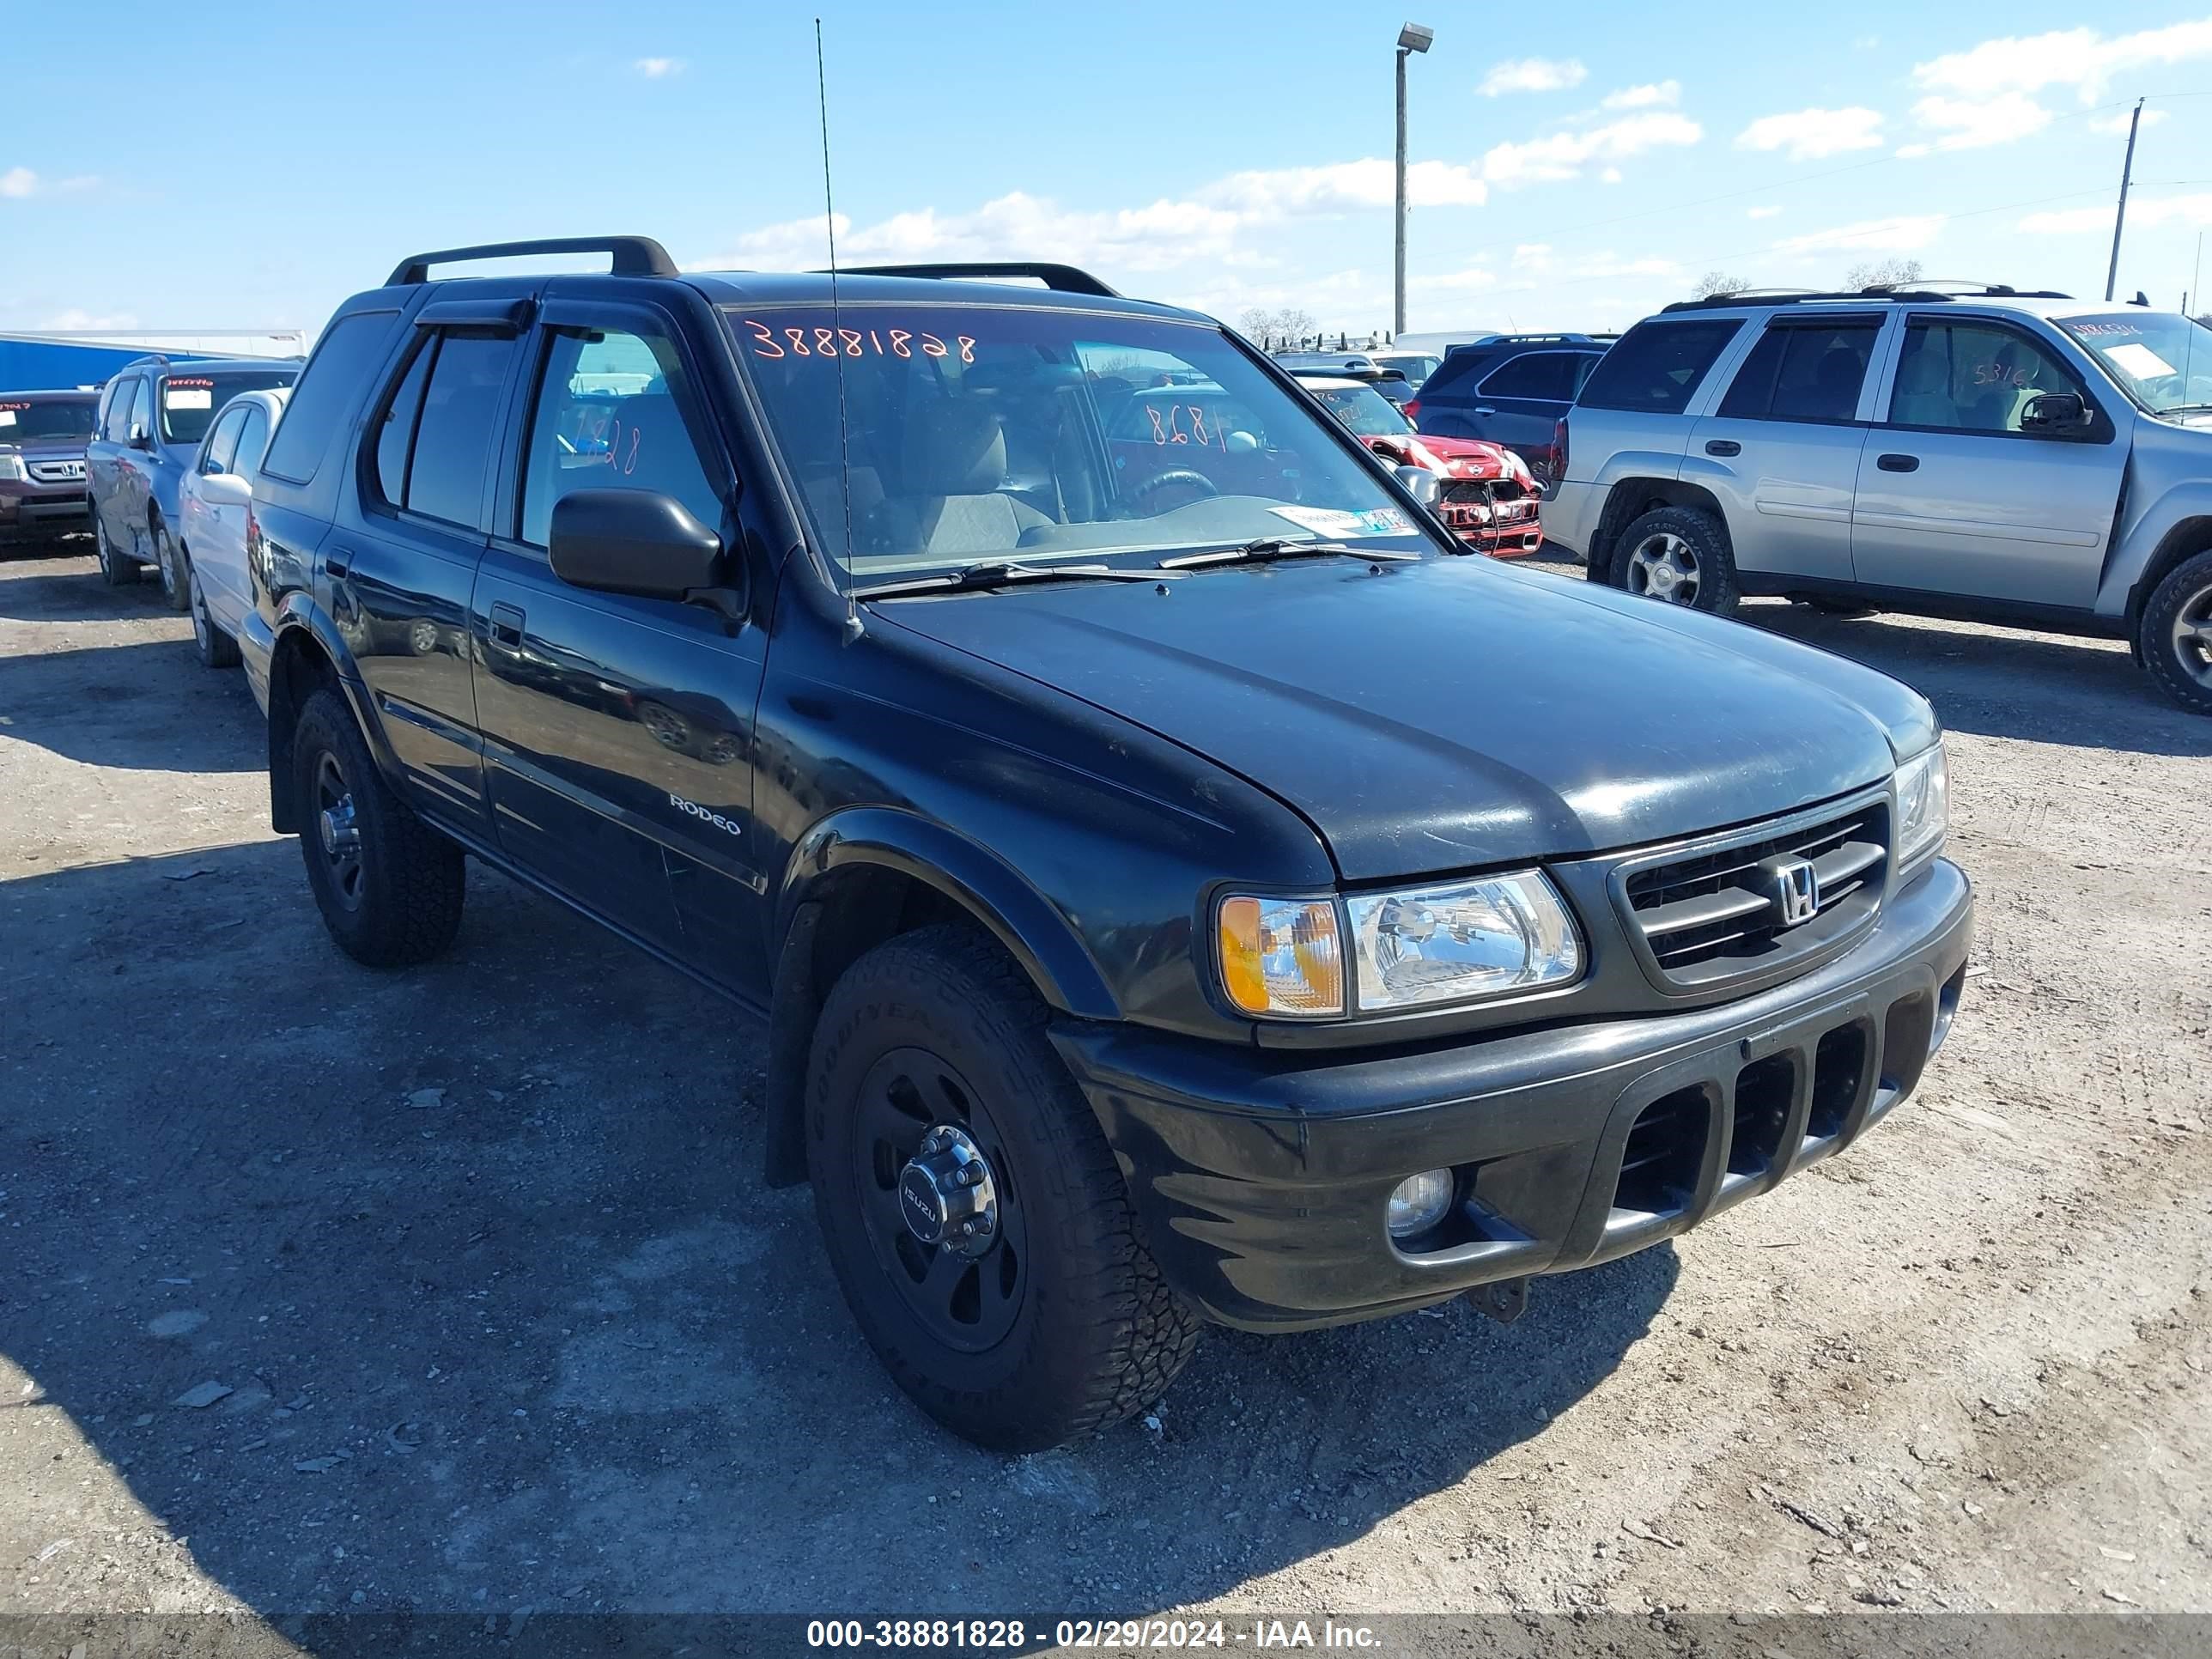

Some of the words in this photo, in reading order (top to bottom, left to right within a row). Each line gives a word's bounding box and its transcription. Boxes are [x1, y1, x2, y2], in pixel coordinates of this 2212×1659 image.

[744, 320, 976, 363] 38881828
[1973, 363, 2027, 386] 5316
[670, 793, 742, 836] RODEO
[904, 1186, 936, 1223] ISUZU
